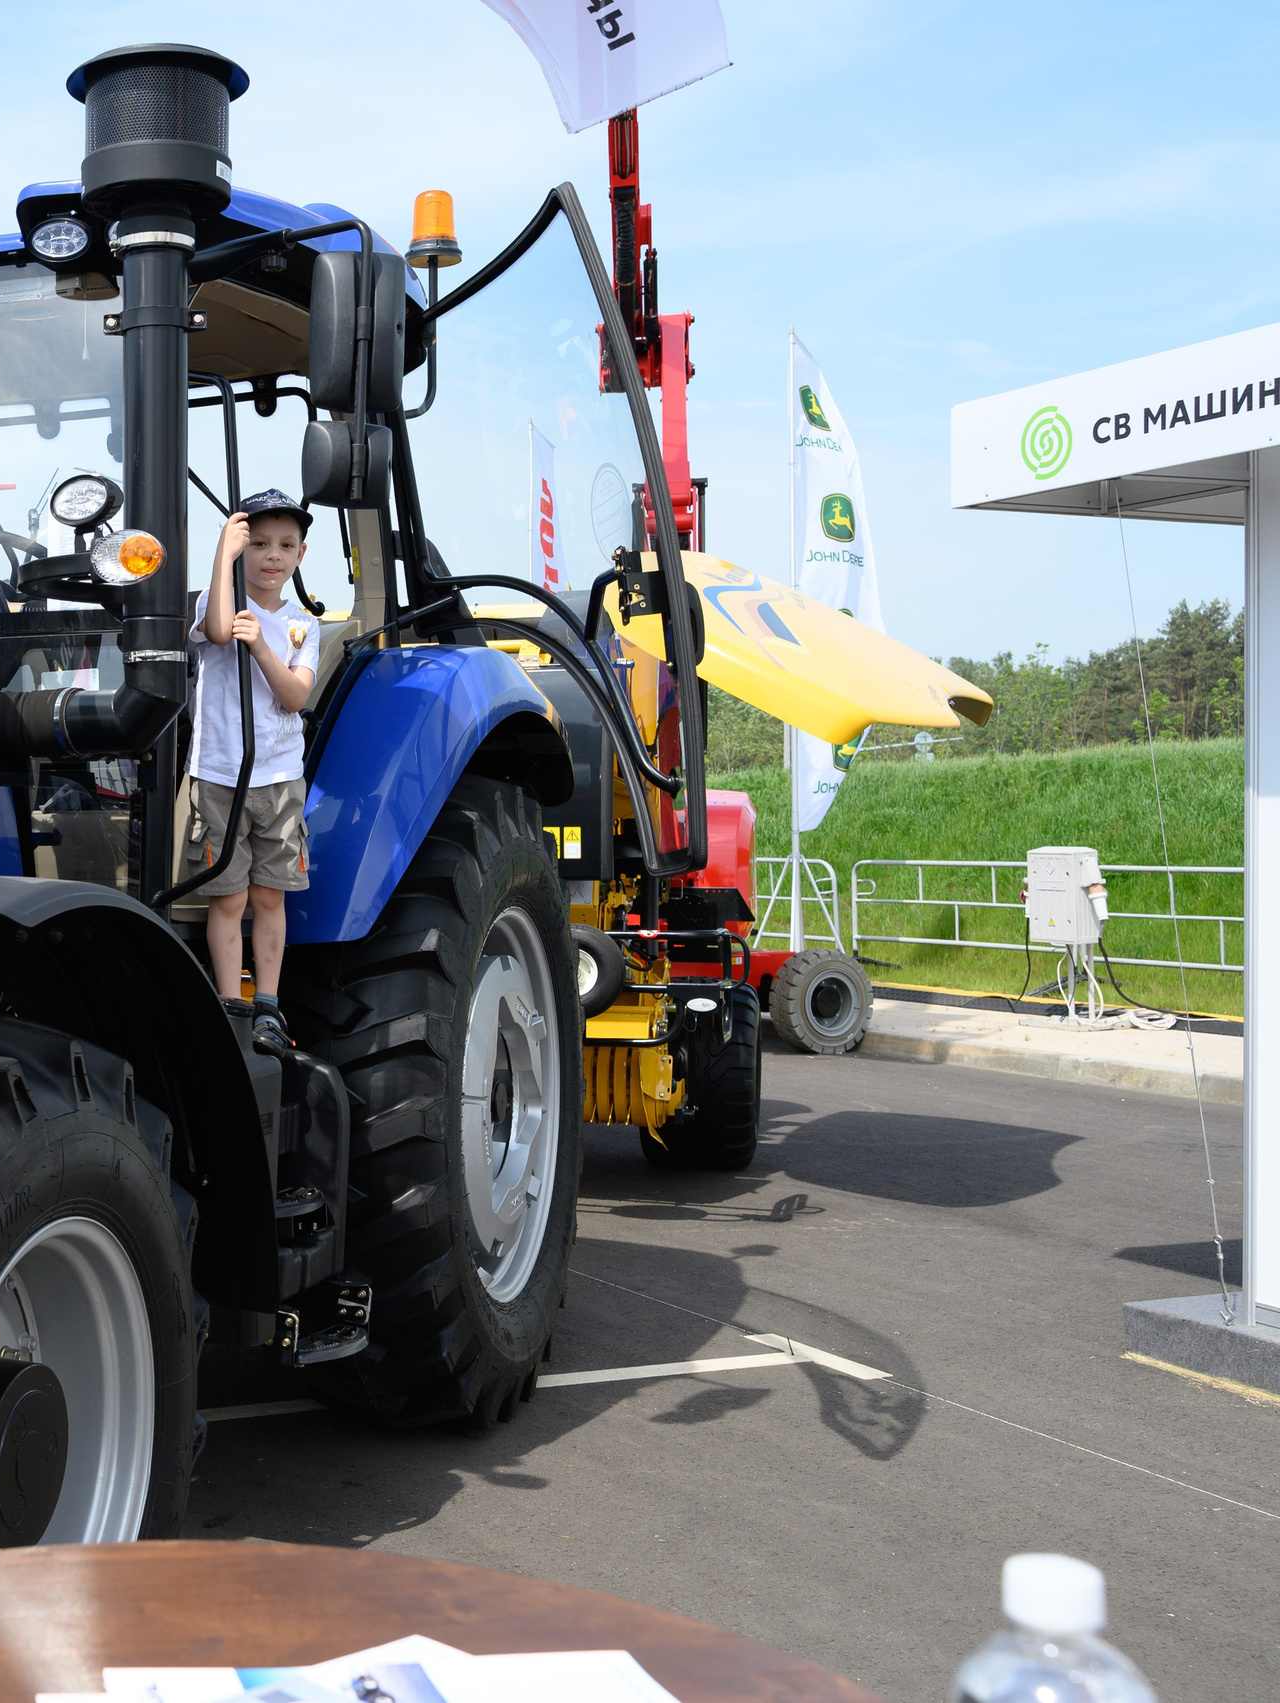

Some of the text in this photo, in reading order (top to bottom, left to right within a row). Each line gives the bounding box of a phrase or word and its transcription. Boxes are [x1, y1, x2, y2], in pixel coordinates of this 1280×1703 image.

[1092, 376, 1280, 444] СВ МАШИН
[795, 434, 827, 449] JOHN
[806, 549, 840, 563] JOHN
